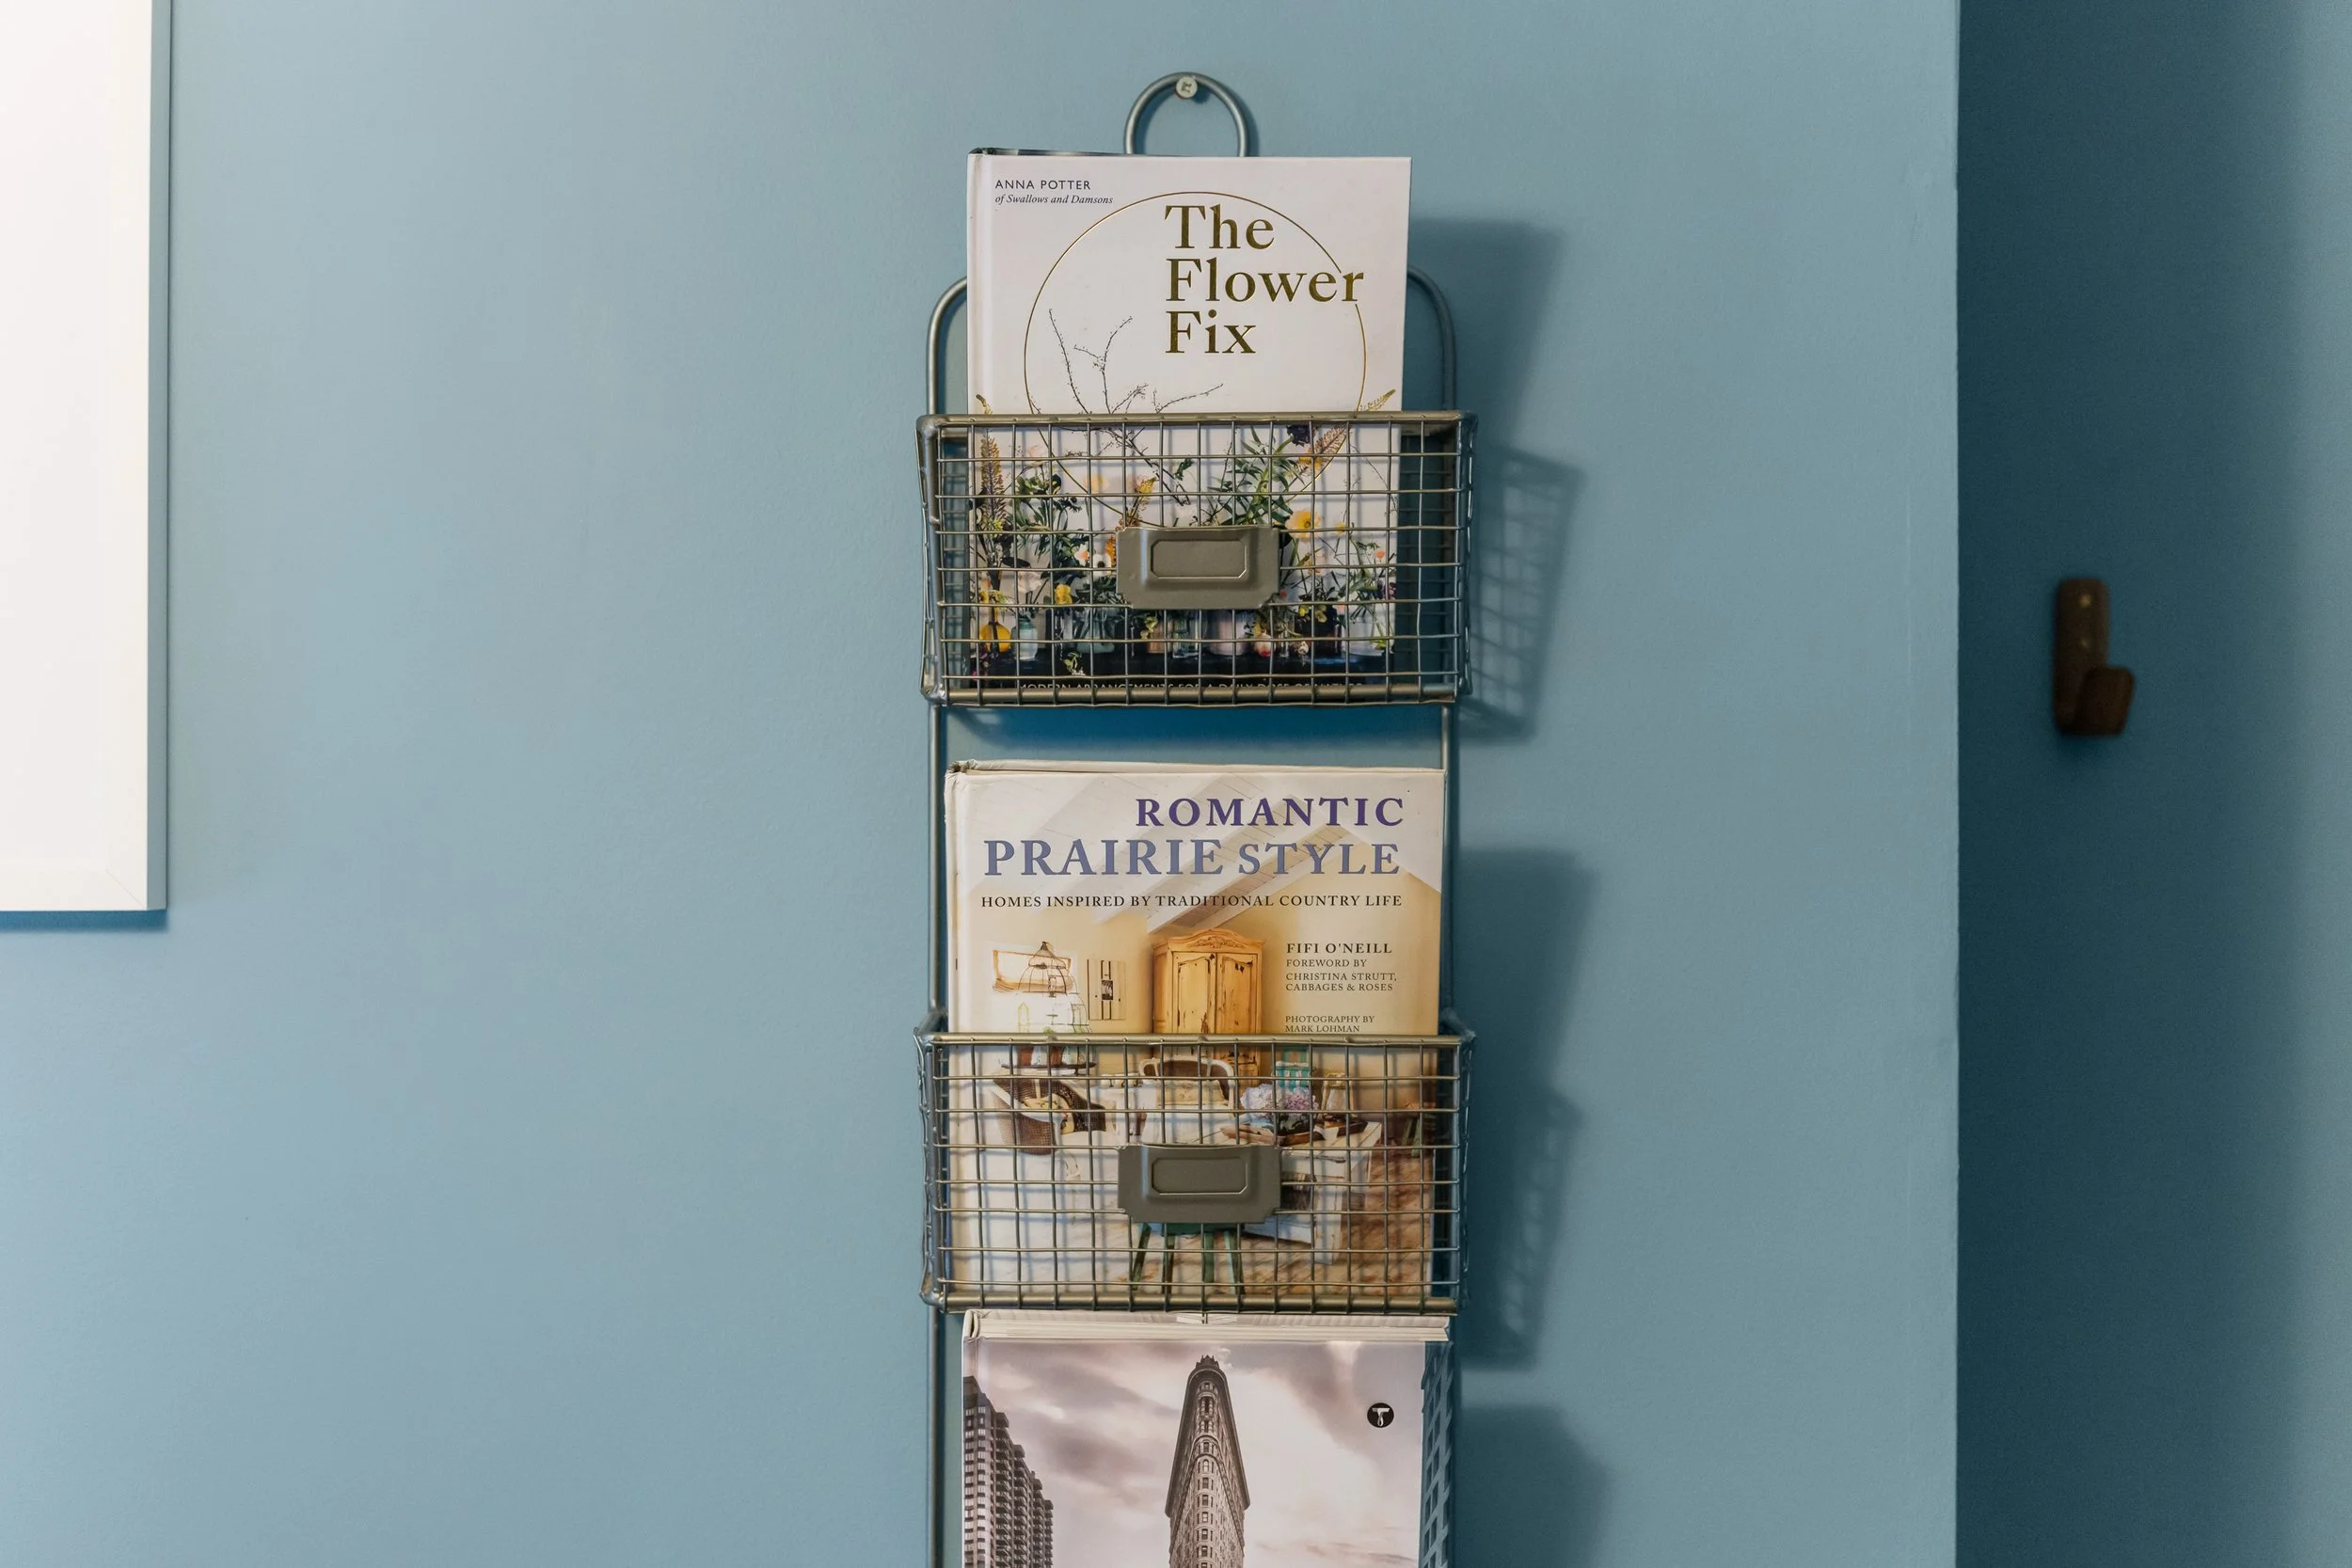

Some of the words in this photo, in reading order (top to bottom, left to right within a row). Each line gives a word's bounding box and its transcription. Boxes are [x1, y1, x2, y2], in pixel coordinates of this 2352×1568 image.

[994, 179, 1035, 190] ANNA
[1041, 179, 1091, 190] POTTER
[994, 194, 1007, 205] of
[1006, 194, 1049, 204] Swallows
[1050, 194, 1070, 204] and
[1071, 194, 1114, 204] Damsons
[1164, 204, 1276, 250] The
[1165, 256, 1365, 303] Flower
[1165, 309, 1257, 355] Fix
[1135, 797, 1405, 828] ROMANTIC
[983, 838, 1224, 877] PRAIRIE
[1237, 843, 1400, 876] STYLE
[980, 895, 1041, 908] HOMES
[1046, 895, 1125, 908] INSPIRED
[1130, 895, 1152, 907] BY
[1154, 895, 1275, 907] TRADITIONAL
[1279, 895, 1361, 907] COUNTRY
[1364, 895, 1403, 907] LIFE
[1286, 942, 1320, 954] FIFI
[1325, 942, 1393, 954] O'NEILL
[1285, 958, 1351, 968] FOREWORD
[1353, 958, 1368, 968] BY
[1285, 973, 1348, 981] CHRISTINA
[1351, 973, 1398, 982] STRUTT,
[1285, 983, 1344, 991] CABBAGES
[1346, 983, 1356, 991] &
[1359, 983, 1393, 991] ROSES
[1284, 1015, 1360, 1023] PHOTOGRAPHY
[1362, 1015, 1375, 1023] BY
[1284, 1024, 1314, 1033] MARK
[1316, 1024, 1361, 1033] LOHMAN
